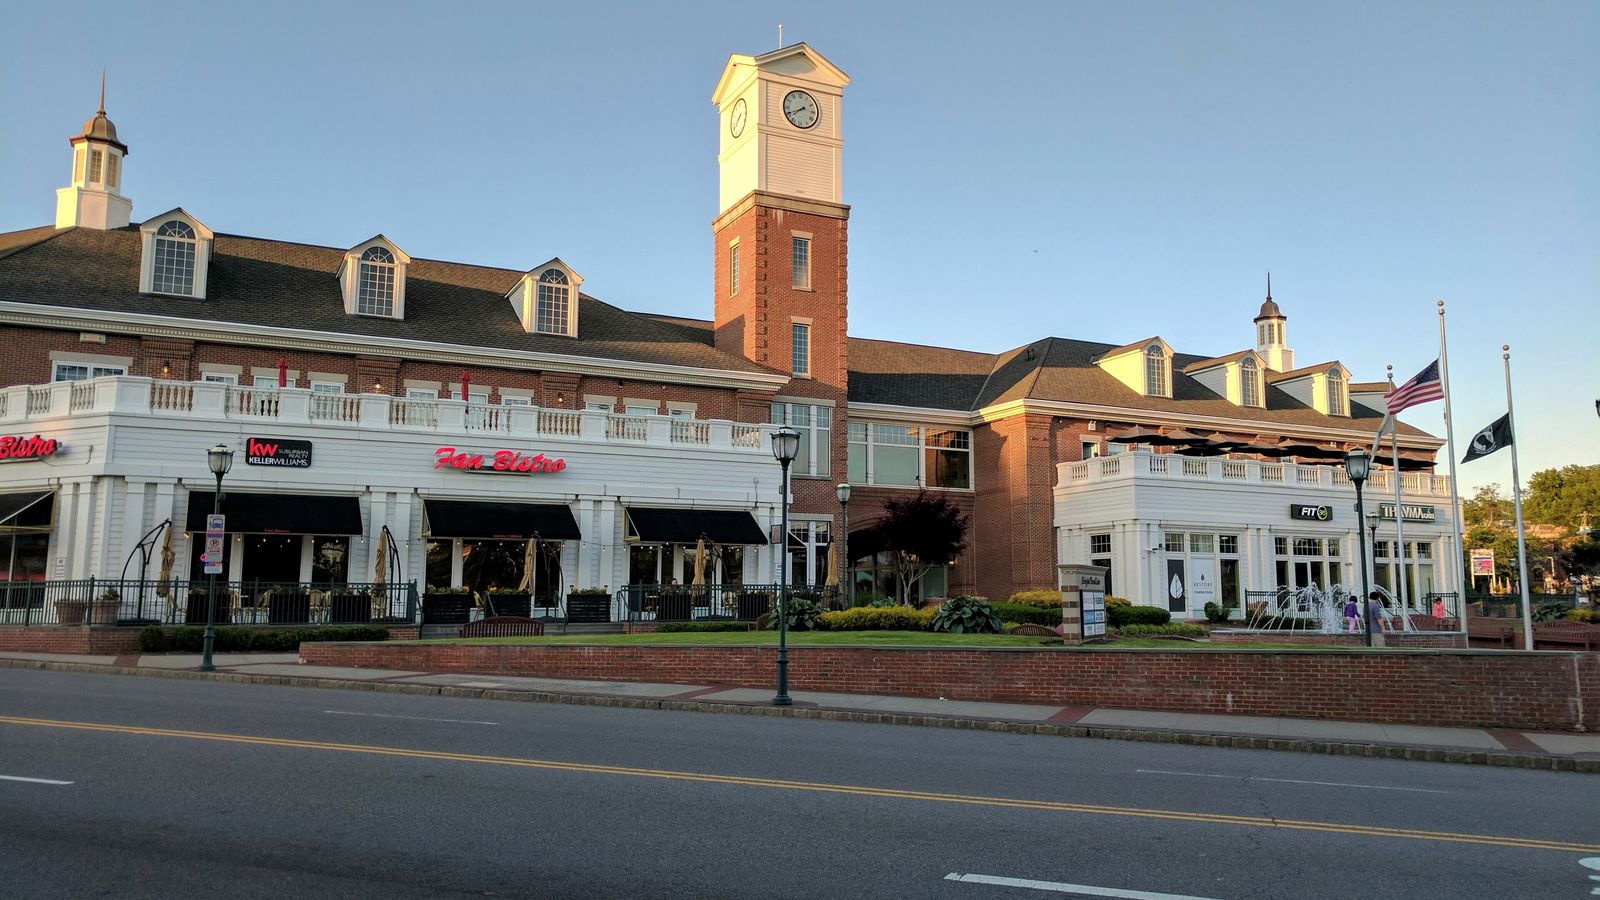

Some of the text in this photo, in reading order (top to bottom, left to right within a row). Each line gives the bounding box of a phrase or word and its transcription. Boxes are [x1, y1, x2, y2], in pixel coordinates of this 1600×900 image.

[250, 438, 278, 456] kw
[435, 447, 566, 473] Fan Bistro
[1301, 507, 1317, 517] FIT
